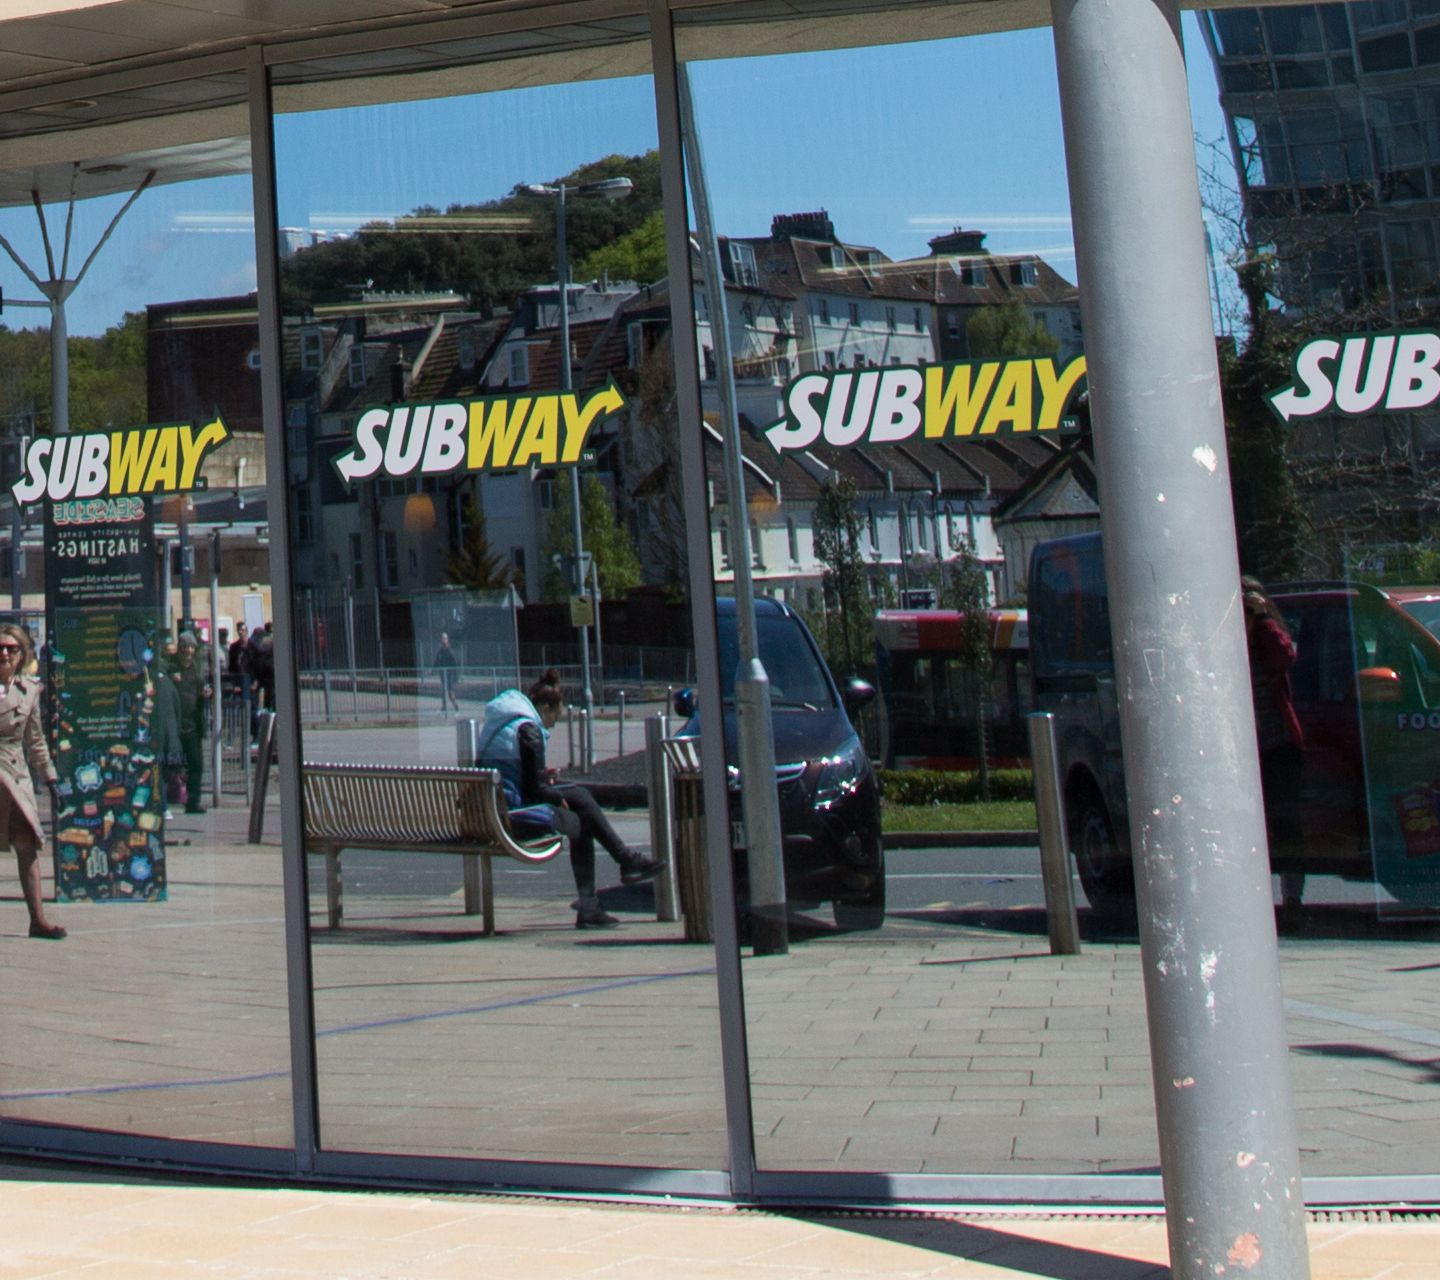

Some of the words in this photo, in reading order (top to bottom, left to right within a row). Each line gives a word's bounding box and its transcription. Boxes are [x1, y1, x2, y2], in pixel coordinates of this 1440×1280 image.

[336, 386, 626, 481] SUBWAY
[765, 356, 1087, 453] SUBWAY
[12, 419, 226, 507] SUBWAY
